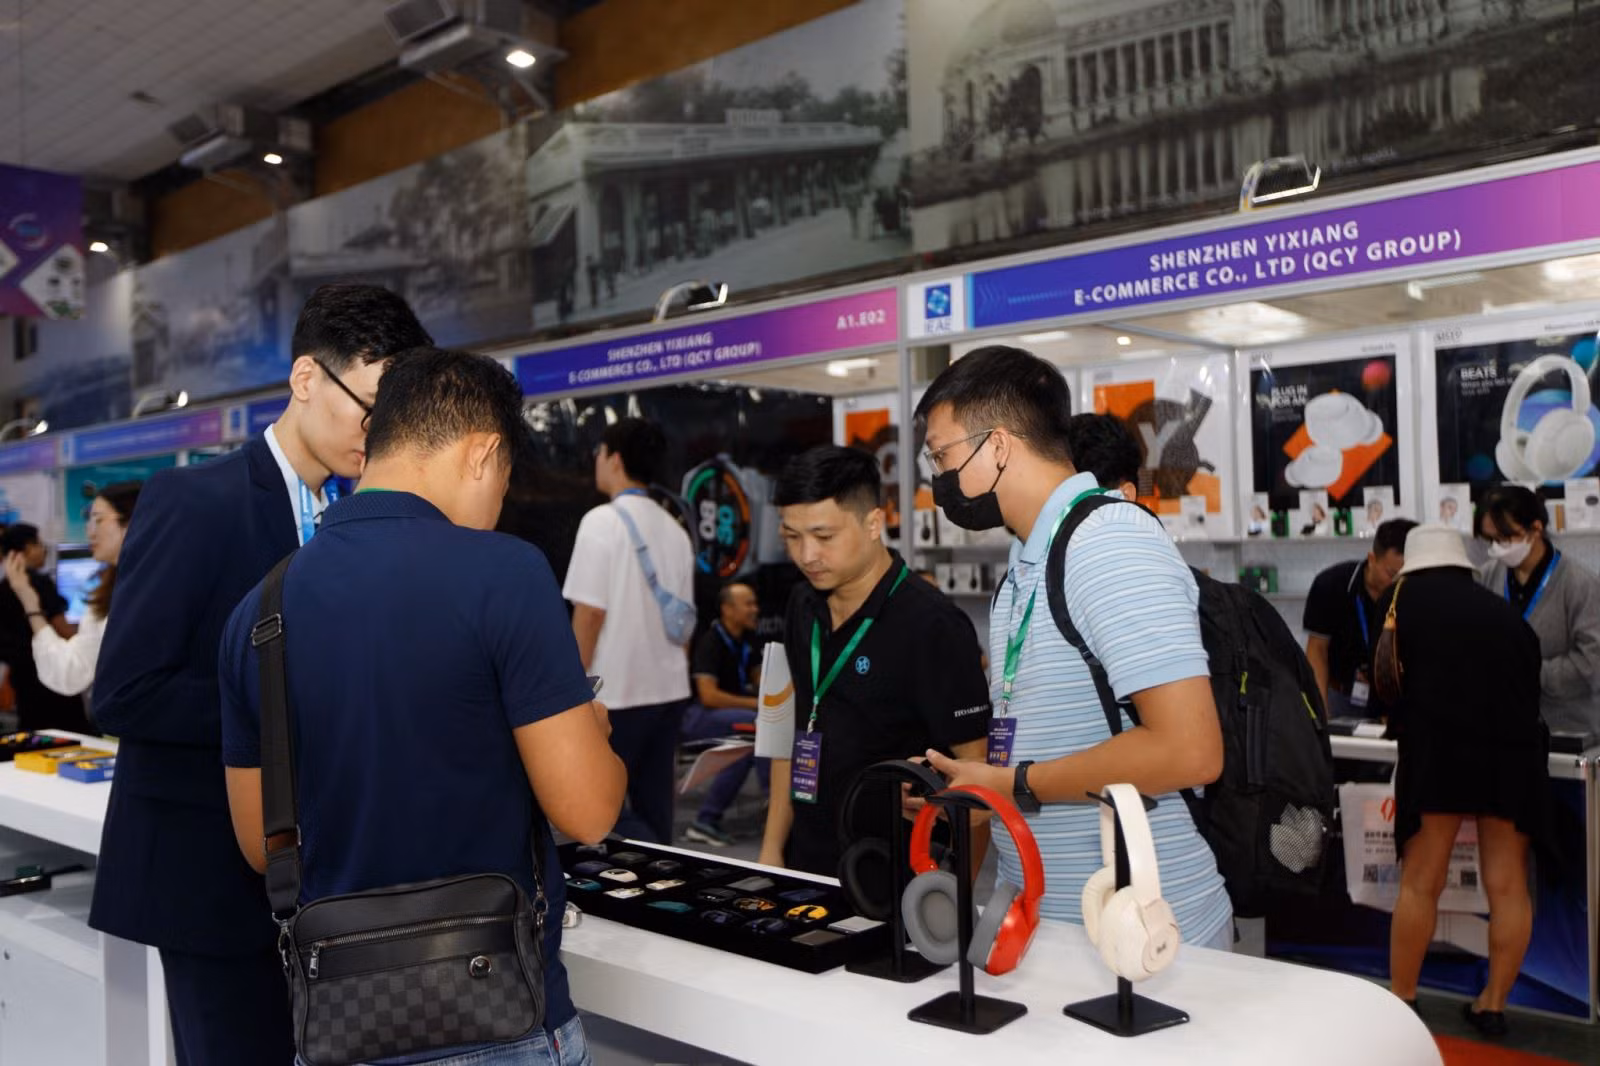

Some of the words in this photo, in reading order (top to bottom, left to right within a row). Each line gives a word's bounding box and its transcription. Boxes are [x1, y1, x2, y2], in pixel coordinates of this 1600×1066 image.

[1150, 238, 1258, 273] SHENZHEN
[1264, 220, 1359, 253] YIXIANG
[1074, 271, 1200, 306] E-COMMERCE
[1205, 266, 1248, 286] CO.,
[1255, 255, 1296, 279] LTD
[1304, 245, 1359, 274] (QCY
[1366, 228, 1461, 262] GROUP)
[836, 309, 886, 331] A1.E02
[607, 340, 664, 362] SHENZHEN
[665, 332, 714, 351] YIXIANG
[659, 353, 682, 370] LTD
[714, 342, 762, 361] GROUP)
[1460, 365, 1498, 380] BEATS
